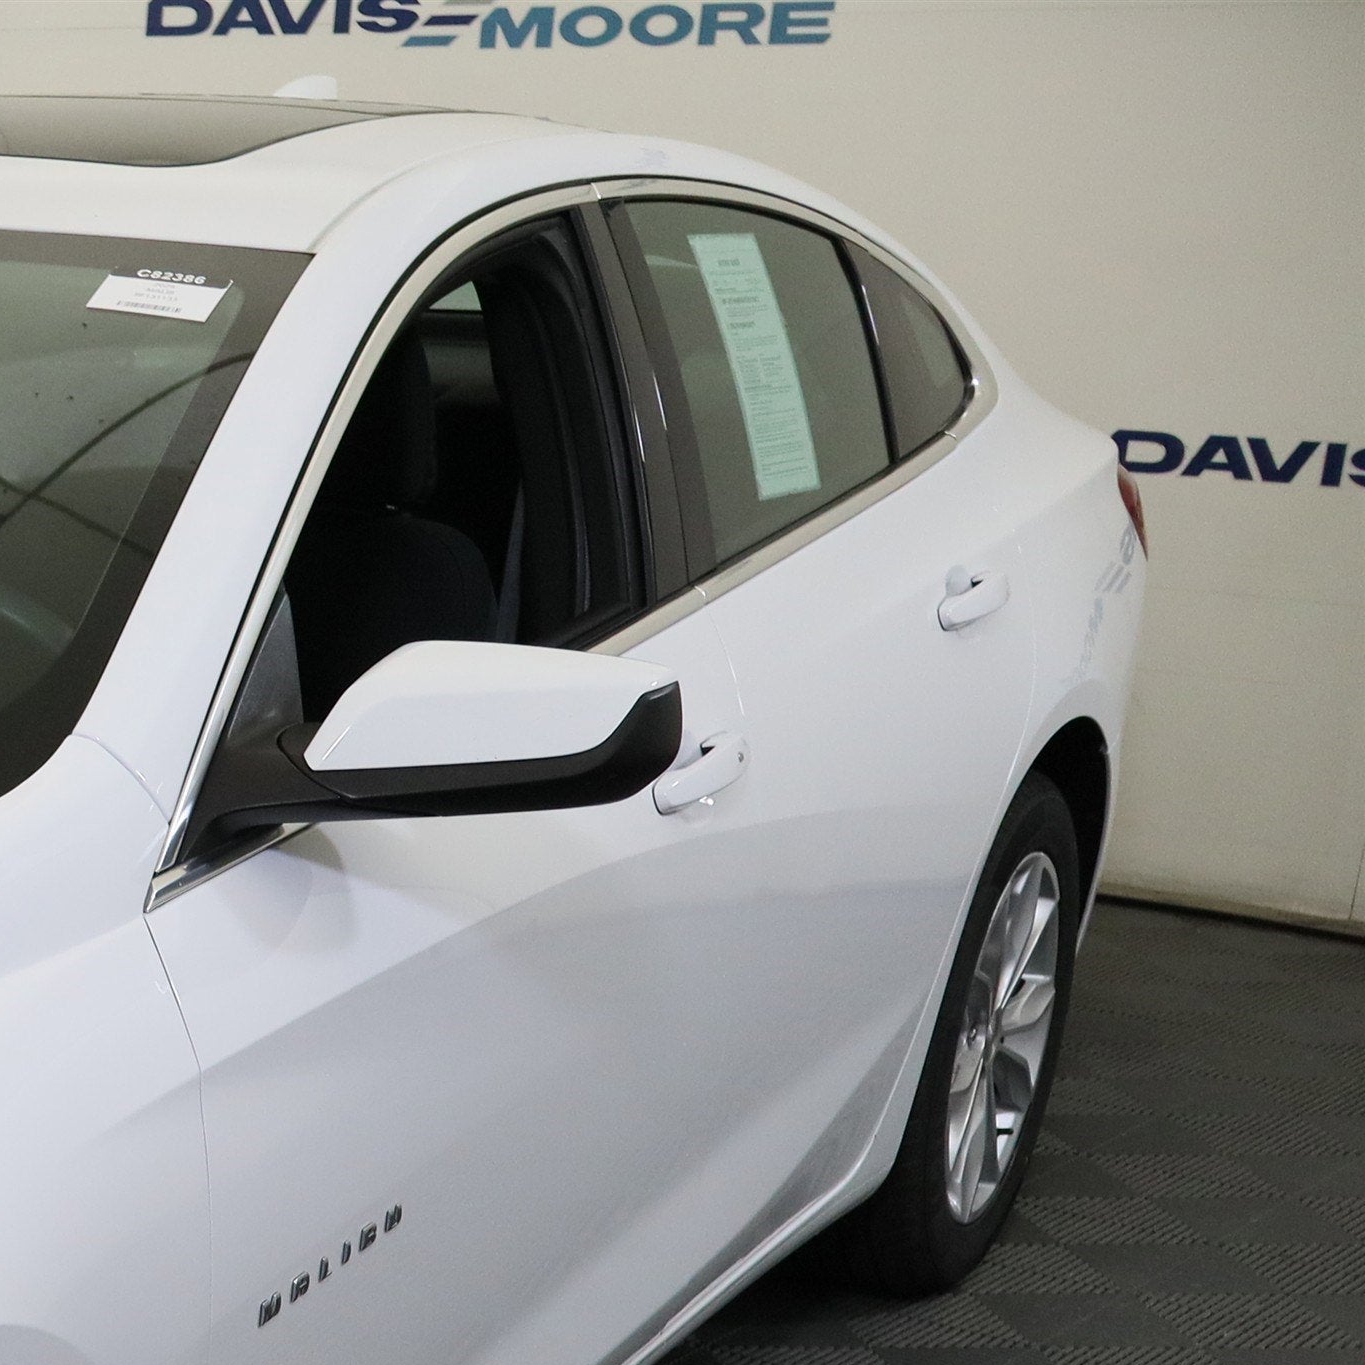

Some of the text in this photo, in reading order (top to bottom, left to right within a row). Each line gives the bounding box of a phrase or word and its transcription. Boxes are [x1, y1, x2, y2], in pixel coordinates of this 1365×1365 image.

[145, 0, 836, 49] DAVIS MOORE
[136, 268, 207, 285] C82386
[1111, 429, 1365, 488] DAVI
